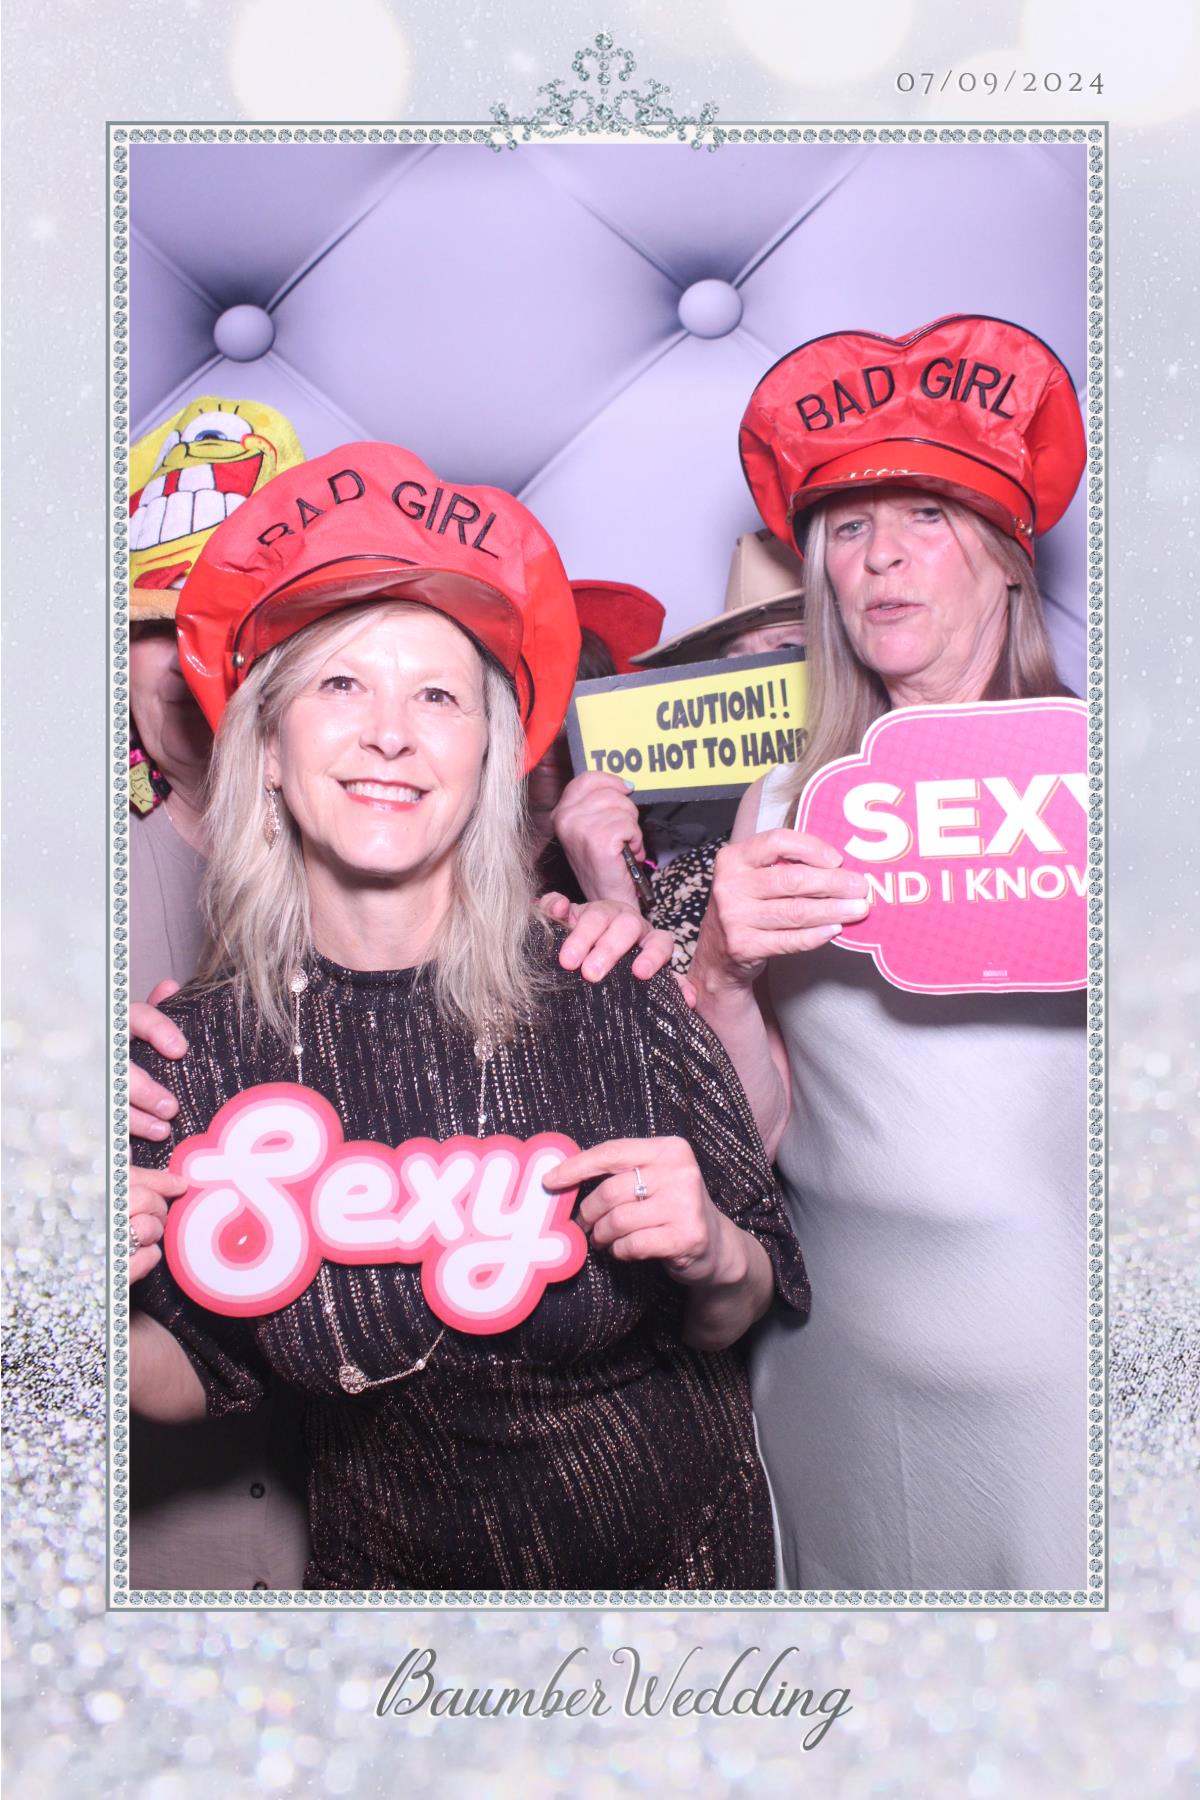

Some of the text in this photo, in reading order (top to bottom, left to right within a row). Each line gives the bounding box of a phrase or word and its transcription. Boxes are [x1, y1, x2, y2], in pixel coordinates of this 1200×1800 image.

[795, 357, 1017, 431] BAD GIRL
[392, 481, 499, 560] GIRL
[656, 678, 790, 731] CAUTION!!
[591, 748, 643, 774] TOO
[648, 739, 697, 773] HOT
[703, 737, 736, 768] TO
[863, 871, 931, 906] ND
[941, 869, 953, 903] I
[183, 1104, 566, 1313] Sexy
